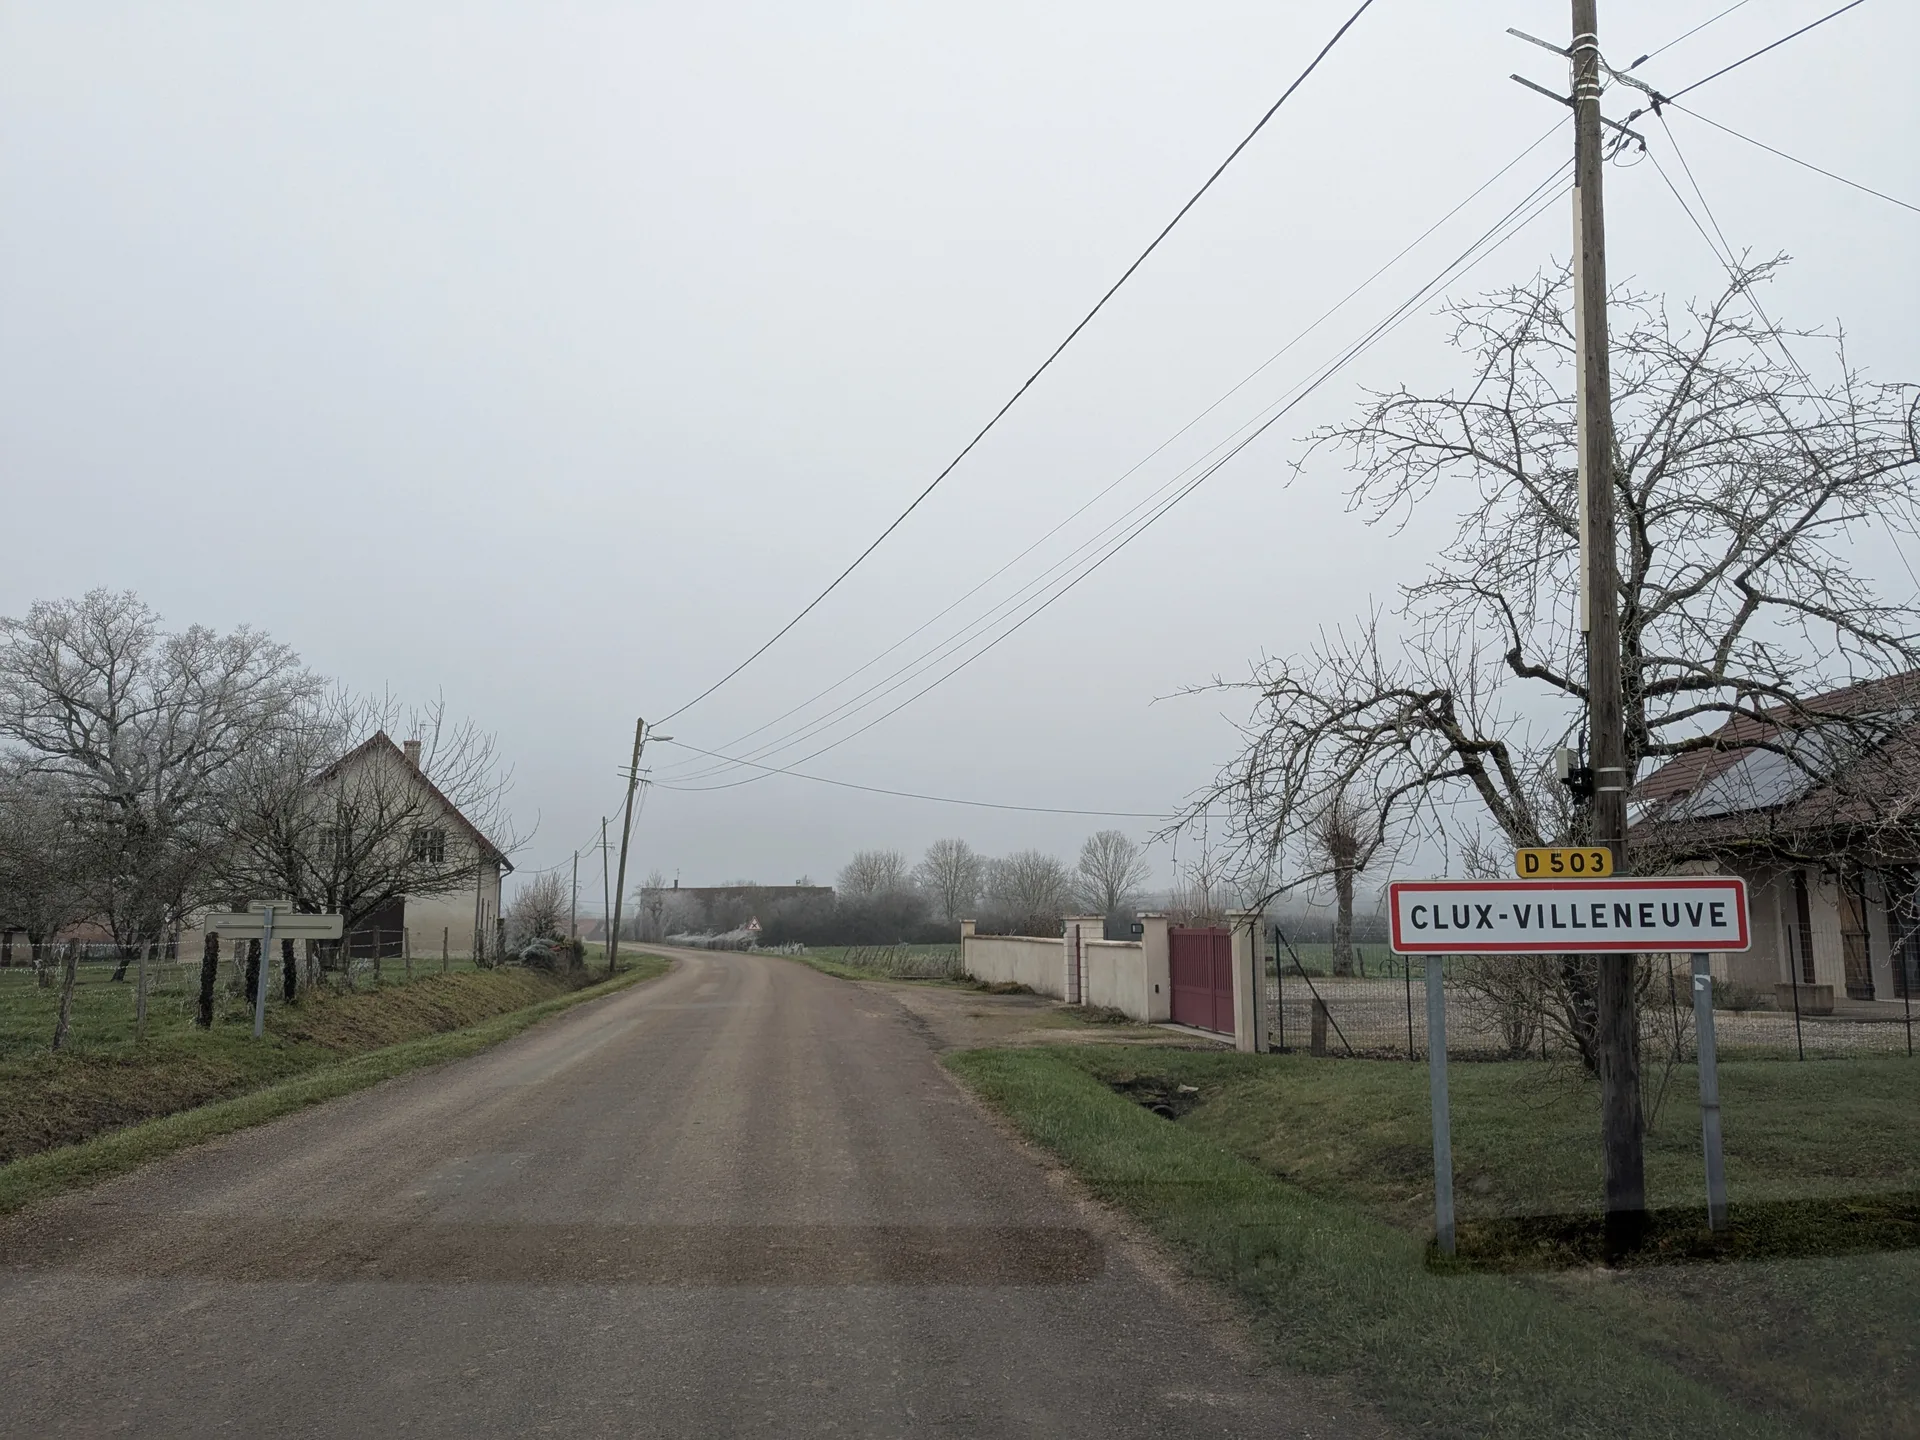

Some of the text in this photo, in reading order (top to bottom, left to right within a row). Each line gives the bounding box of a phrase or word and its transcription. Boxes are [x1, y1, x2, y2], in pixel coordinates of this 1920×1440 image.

[1525, 852, 1604, 873] D 503
[1411, 902, 1727, 930] CLUX-VILLENEUVE
